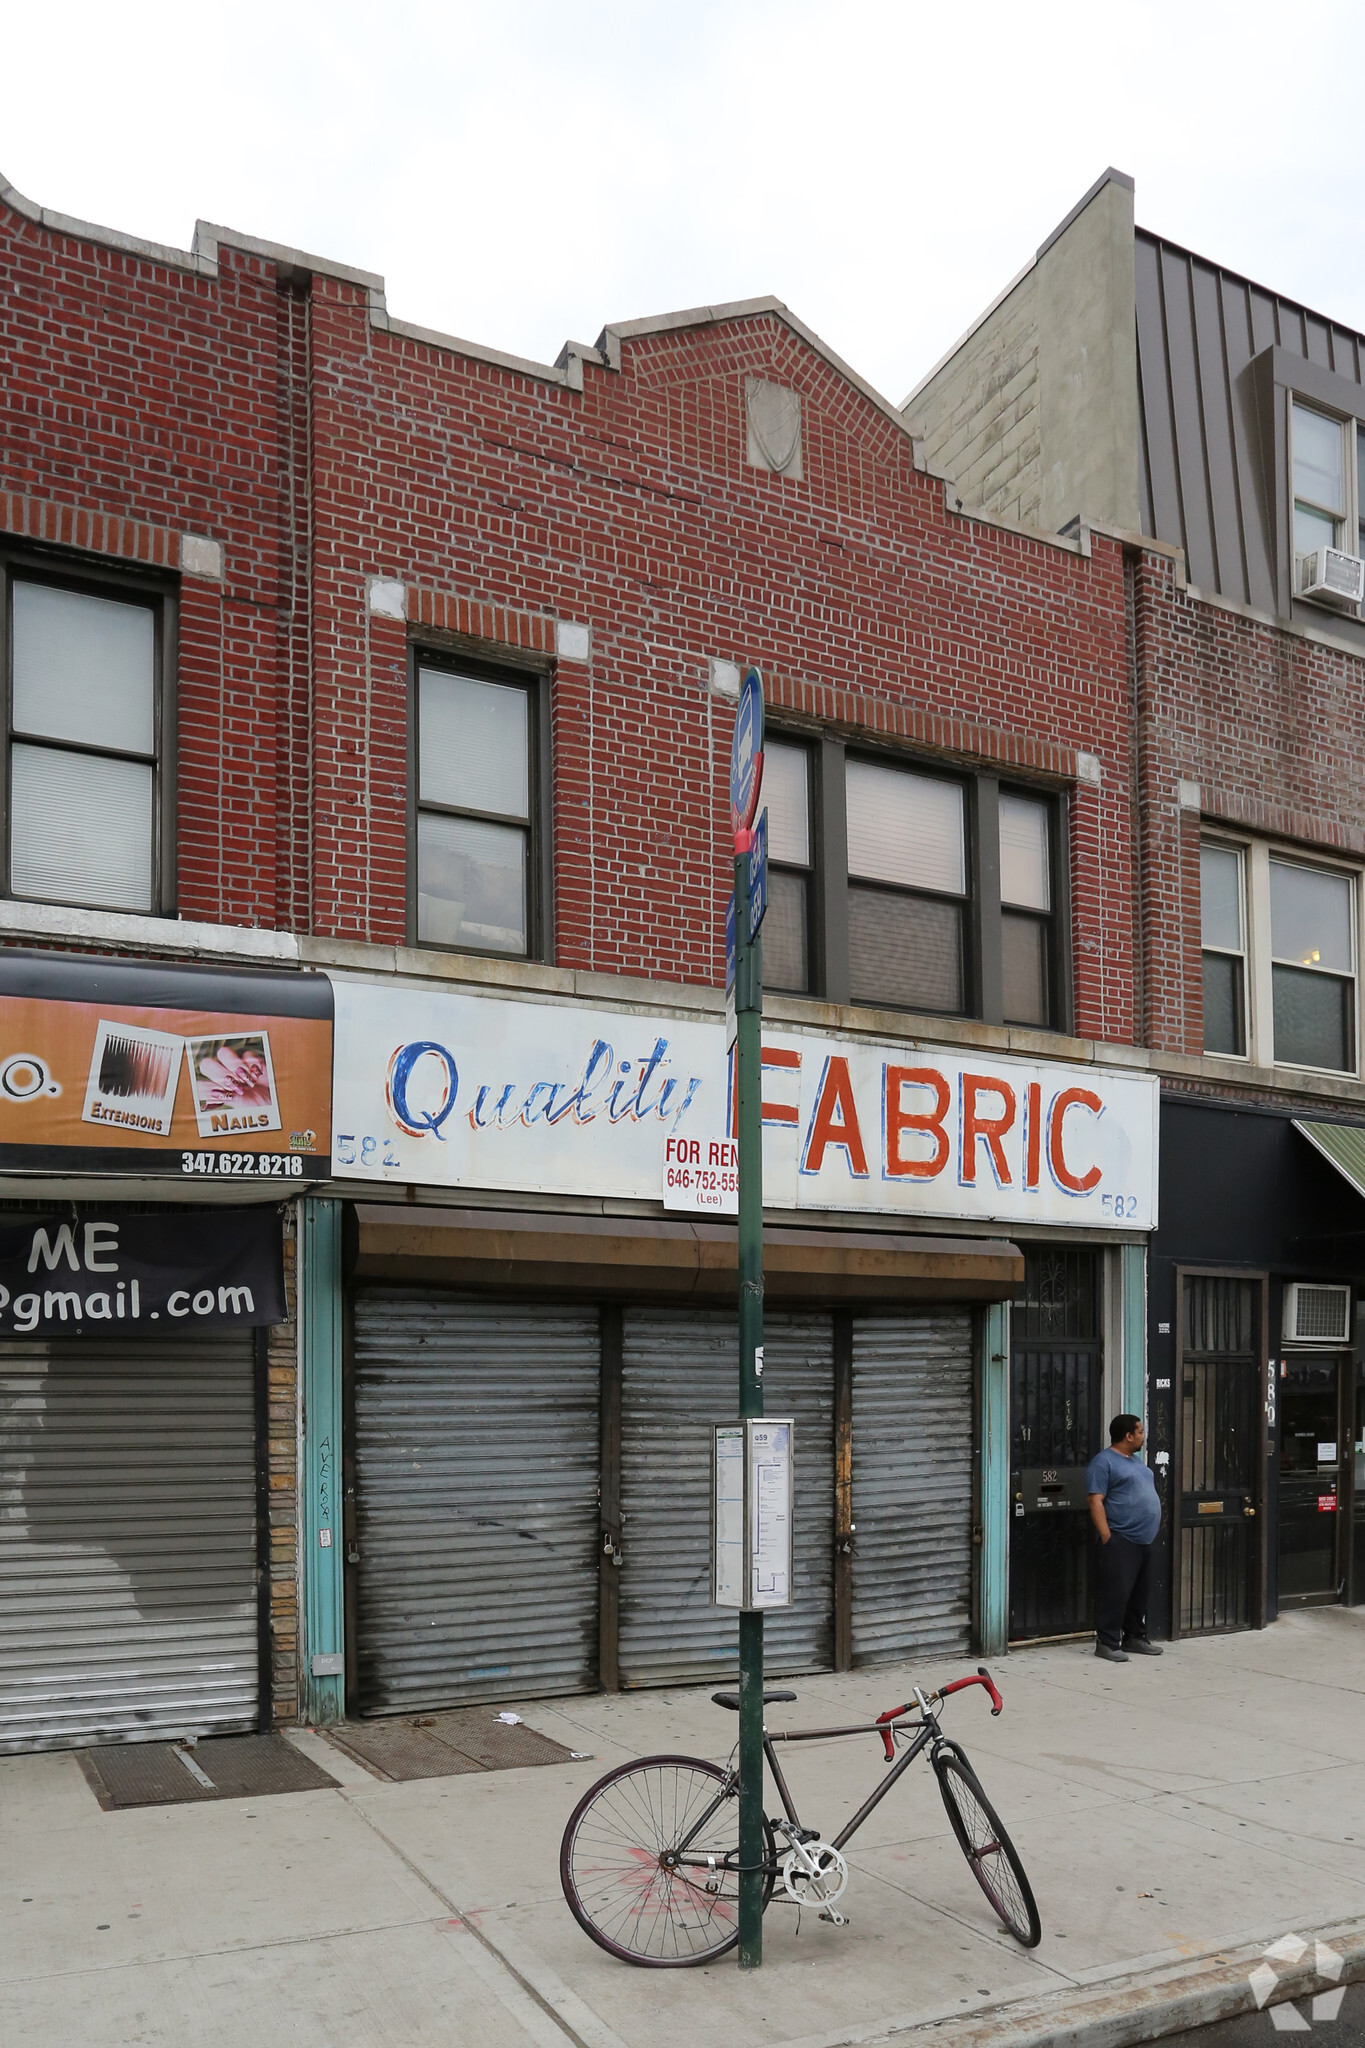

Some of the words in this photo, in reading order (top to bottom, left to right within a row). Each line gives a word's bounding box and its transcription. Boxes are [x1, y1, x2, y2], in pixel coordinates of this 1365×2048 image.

[385, 1037, 702, 1142] Quality
[726, 1045, 1107, 1197] FABRIC
[181, 1152, 303, 1176] 347.622.8218
[337, 1134, 401, 1167] 582
[666, 1138, 700, 1164] FOR
[709, 1142, 739, 1168] REN
[667, 1168, 740, 1192] 646-752-555
[696, 1193, 722, 1206] (Lee)
[1102, 1194, 1137, 1218] 582
[27, 1222, 119, 1273] ME
[1042, 1470, 1058, 1482] 582
